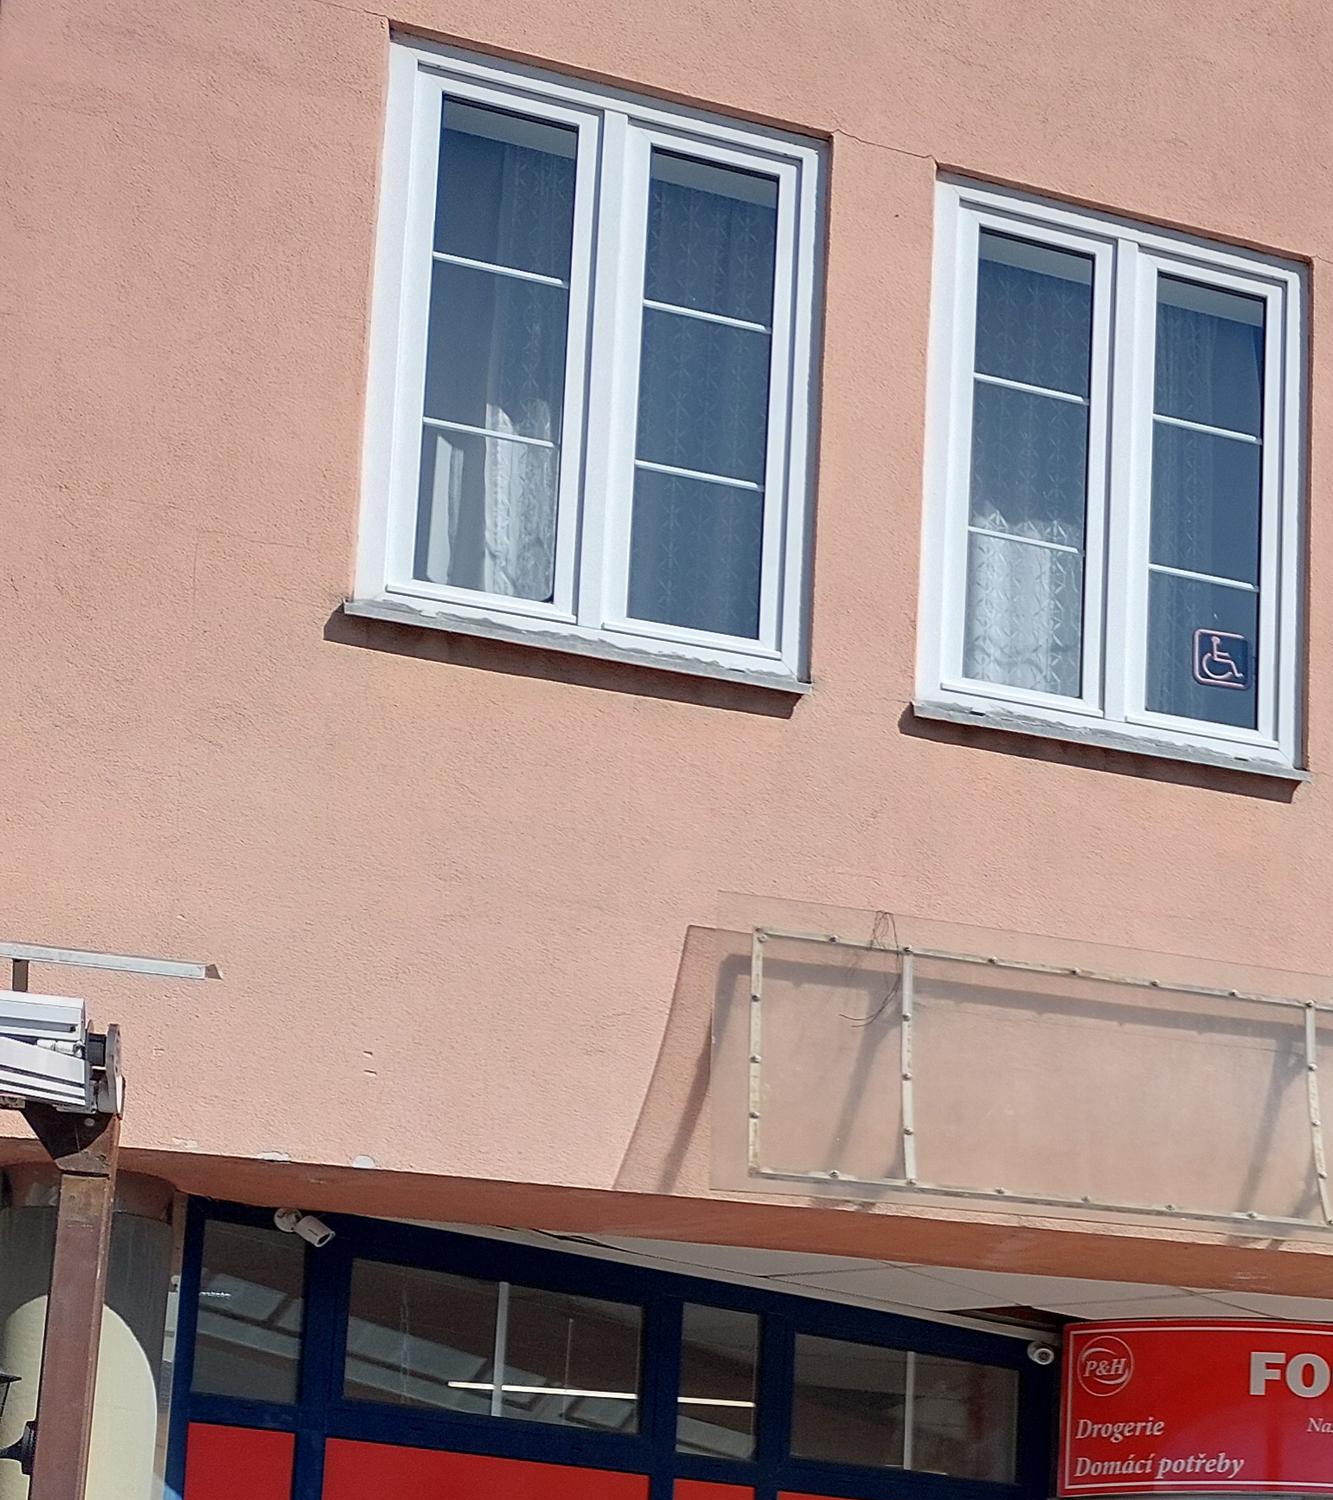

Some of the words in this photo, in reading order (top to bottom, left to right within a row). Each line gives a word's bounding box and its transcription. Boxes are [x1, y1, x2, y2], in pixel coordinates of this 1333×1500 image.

[1083, 1357, 1128, 1378] P&H
[1075, 1416, 1165, 1444] Drogerie
[1074, 1452, 1156, 1477] Domácí
[1154, 1452, 1246, 1480] potřeby
